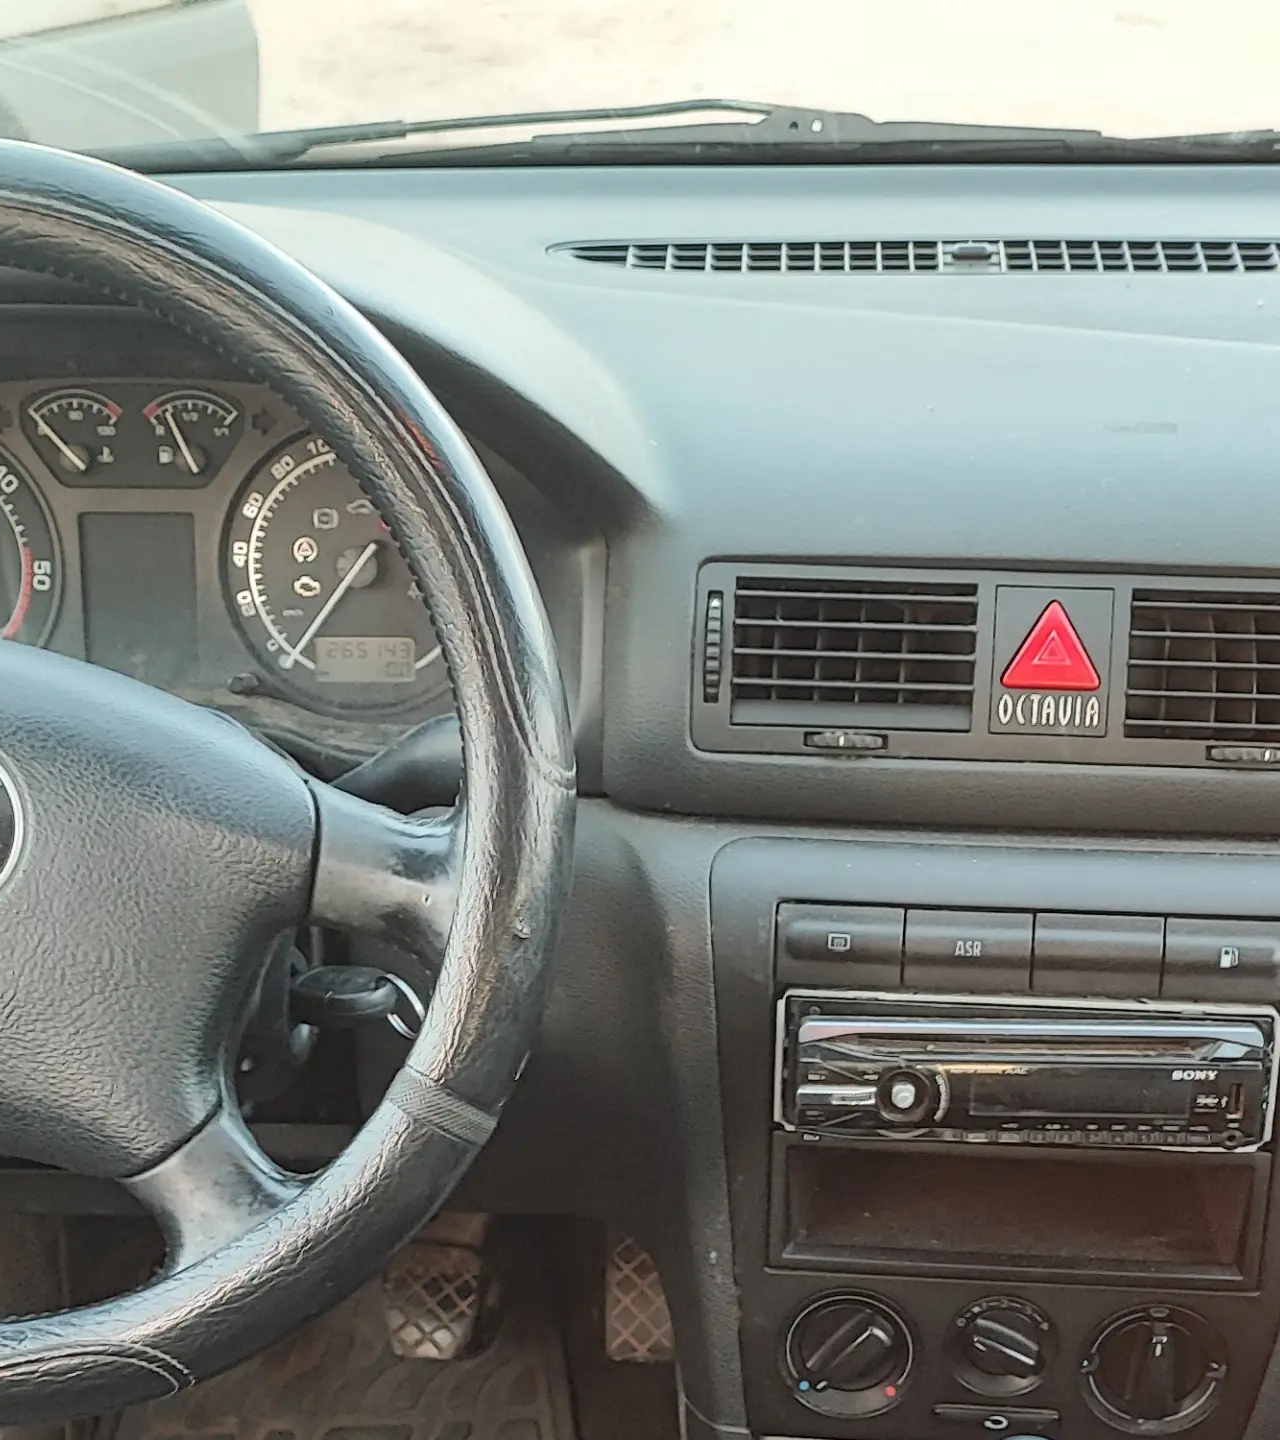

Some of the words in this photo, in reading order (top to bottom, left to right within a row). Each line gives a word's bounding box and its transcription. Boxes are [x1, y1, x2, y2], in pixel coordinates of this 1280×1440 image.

[306, 438, 331, 455] 10
[270, 455, 296, 481] 80
[242, 491, 264, 519] 60
[232, 541, 249, 569] 40
[32, 560, 52, 591] 50
[236, 589, 257, 618] 20
[998, 693, 1100, 728] OCTAVIA
[954, 940, 982, 957] ASR
[1171, 1069, 1219, 1081] SONY
